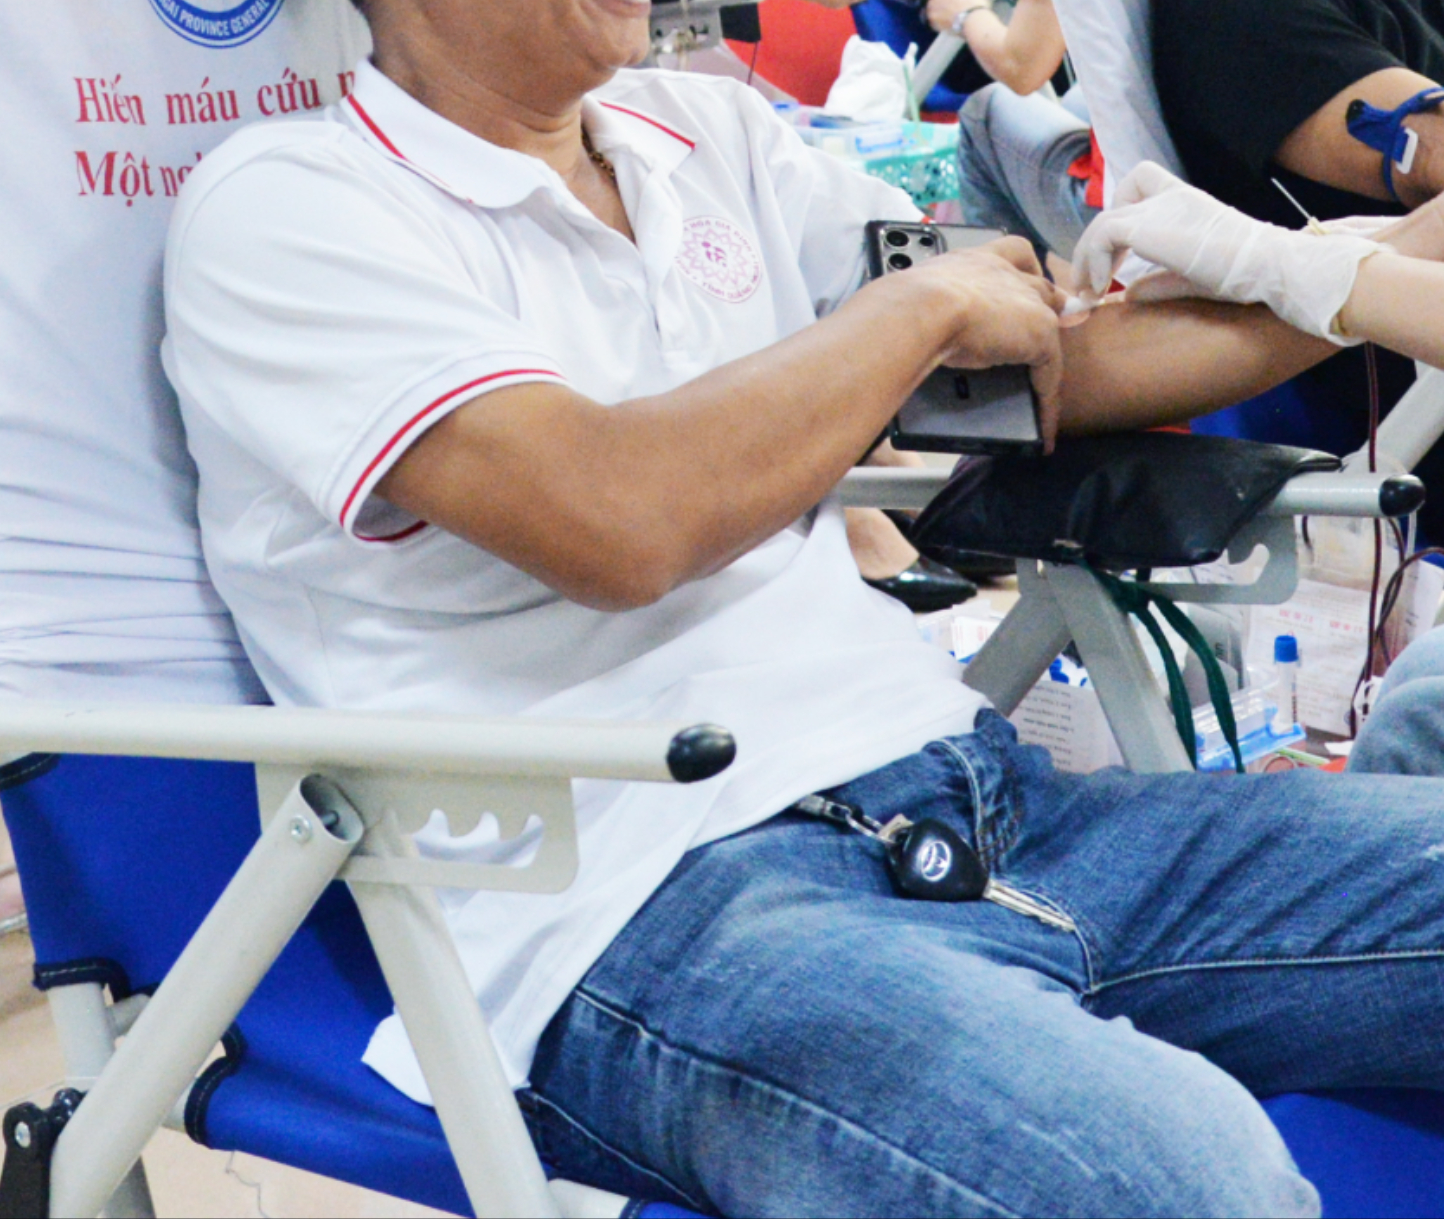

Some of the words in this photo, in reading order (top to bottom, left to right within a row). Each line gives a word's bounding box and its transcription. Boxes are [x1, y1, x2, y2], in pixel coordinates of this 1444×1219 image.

[178, 8, 231, 37] PROVINCE
[73, 73, 146, 126] Hiến
[165, 76, 241, 125] máu
[257, 67, 323, 117] cứu
[74, 150, 156, 208] Một
